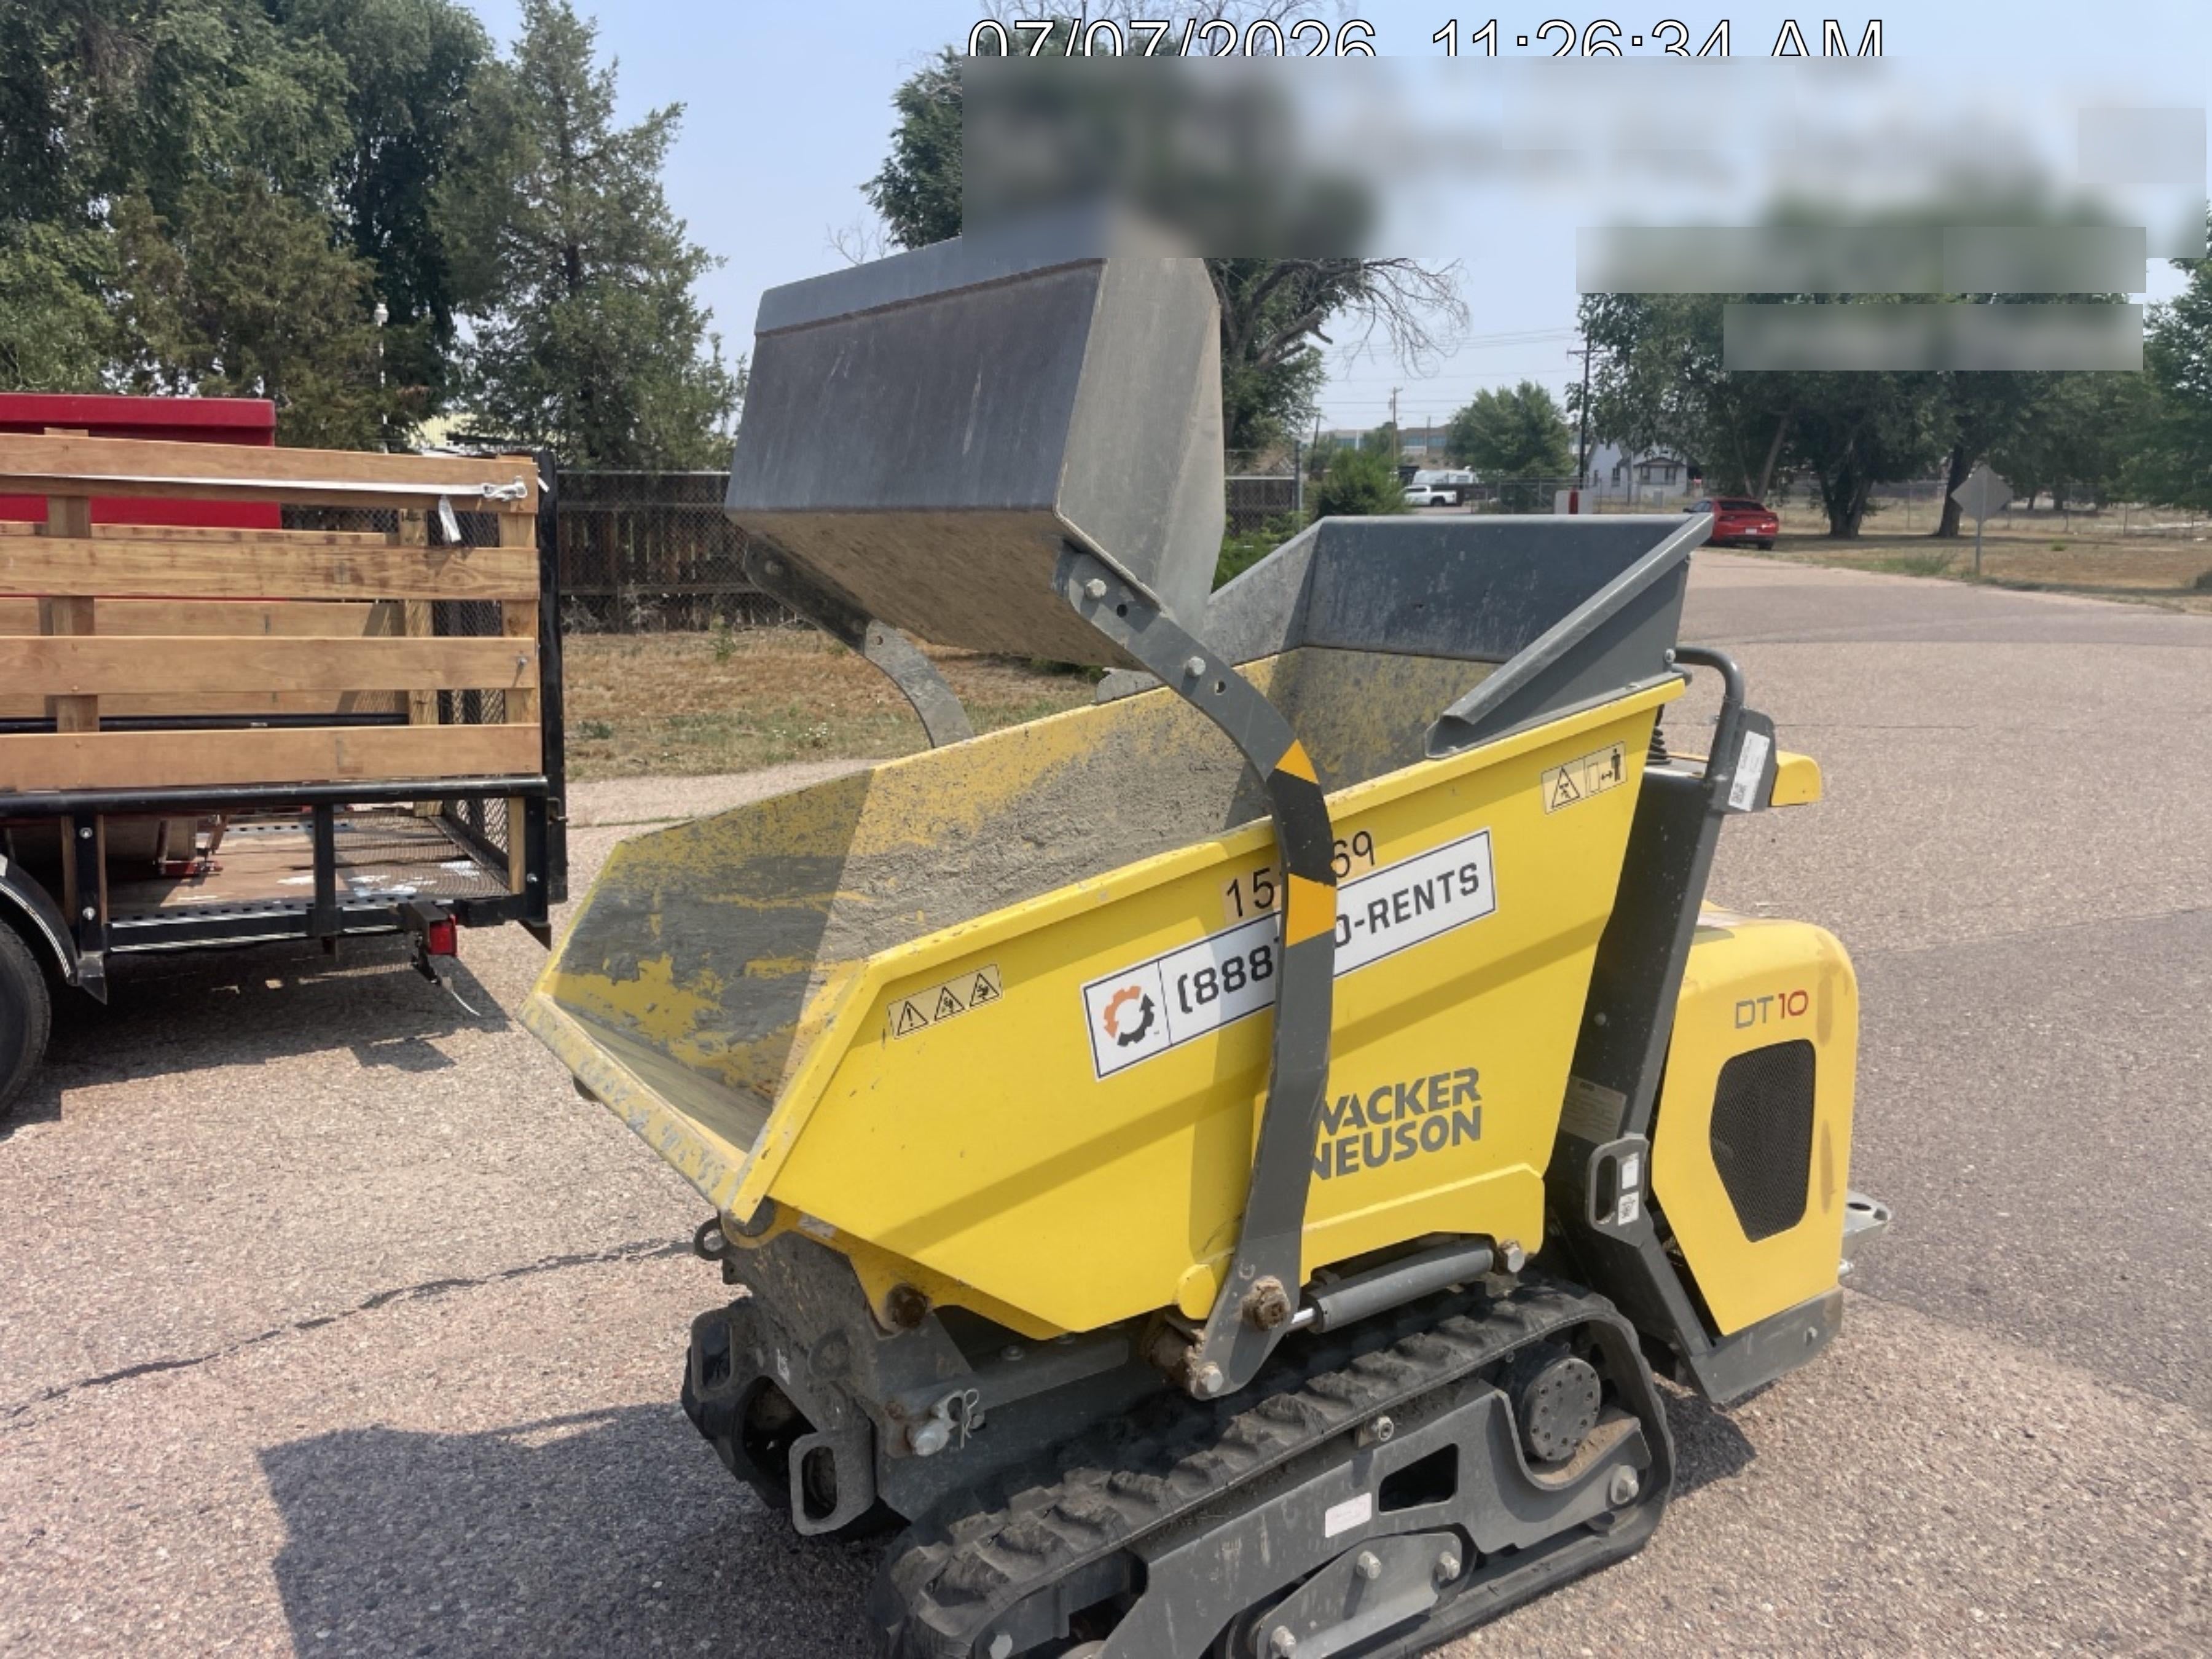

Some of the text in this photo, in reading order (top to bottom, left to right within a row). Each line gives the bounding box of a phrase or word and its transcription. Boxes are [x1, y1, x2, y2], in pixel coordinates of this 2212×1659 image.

[1226, 831, 1375, 917] 1569
[1177, 937, 1280, 1014] (888
[1735, 989, 1809, 1029] DT10
